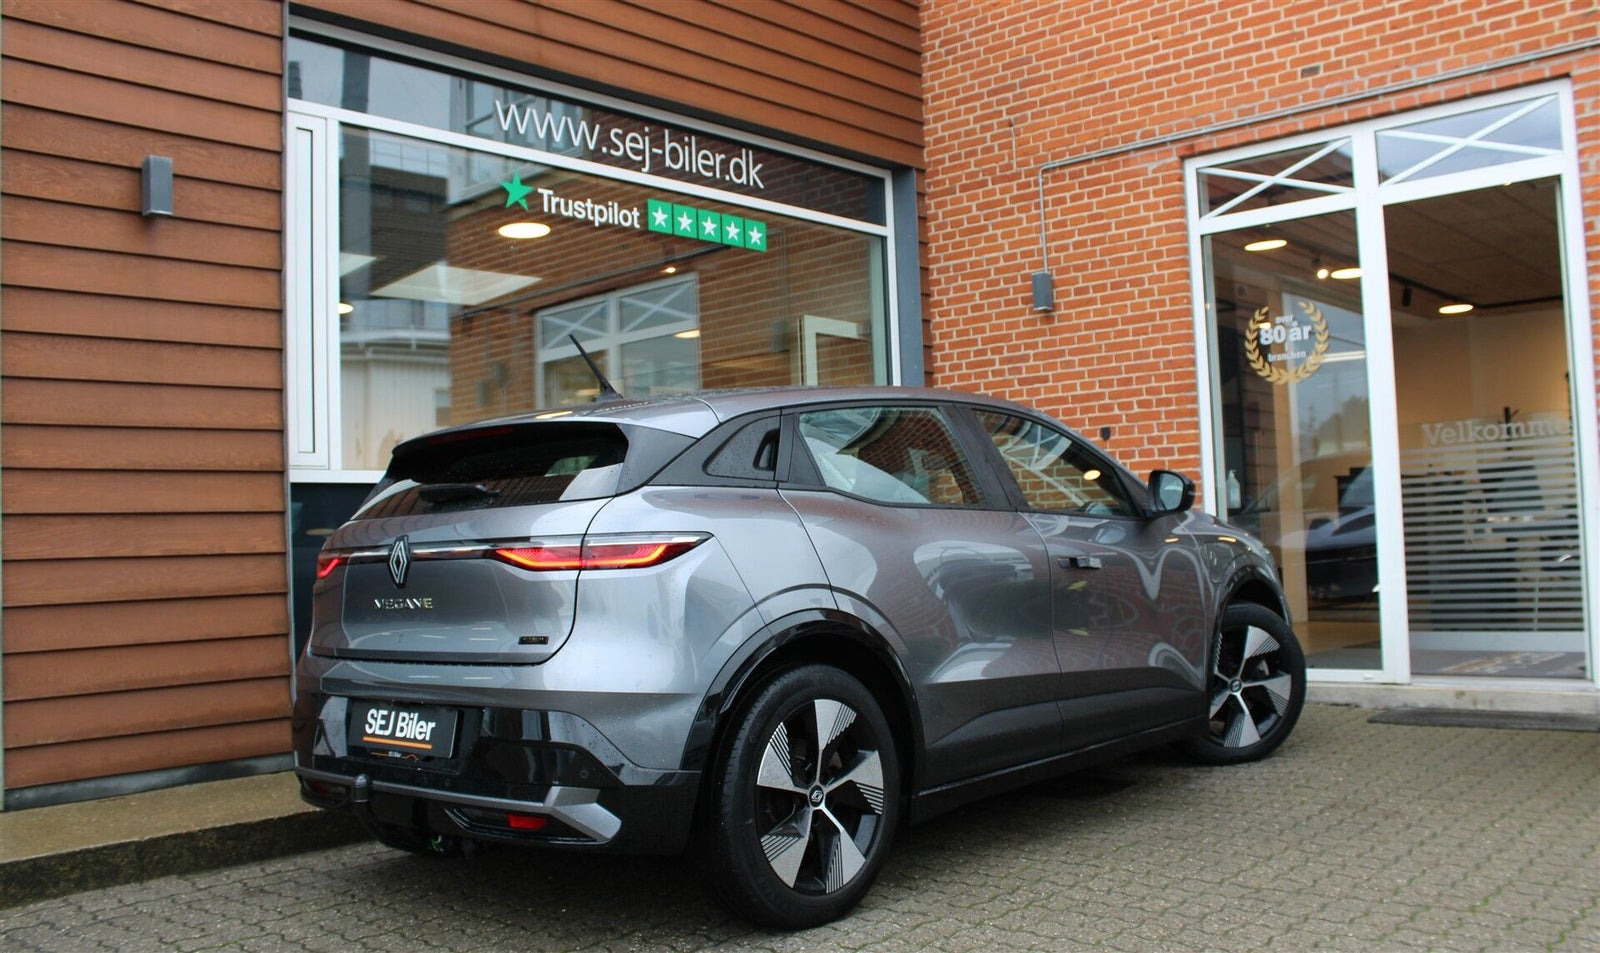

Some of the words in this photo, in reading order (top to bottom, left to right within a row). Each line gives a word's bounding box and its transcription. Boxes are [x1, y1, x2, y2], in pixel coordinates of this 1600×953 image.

[495, 99, 764, 189] www.sej-biler.dk
[537, 188, 640, 229] Trustpilot
[1260, 325, 1287, 345] 80
[1289, 321, 1312, 341] år
[365, 708, 396, 736] SEJ
[395, 711, 437, 741] Biler
